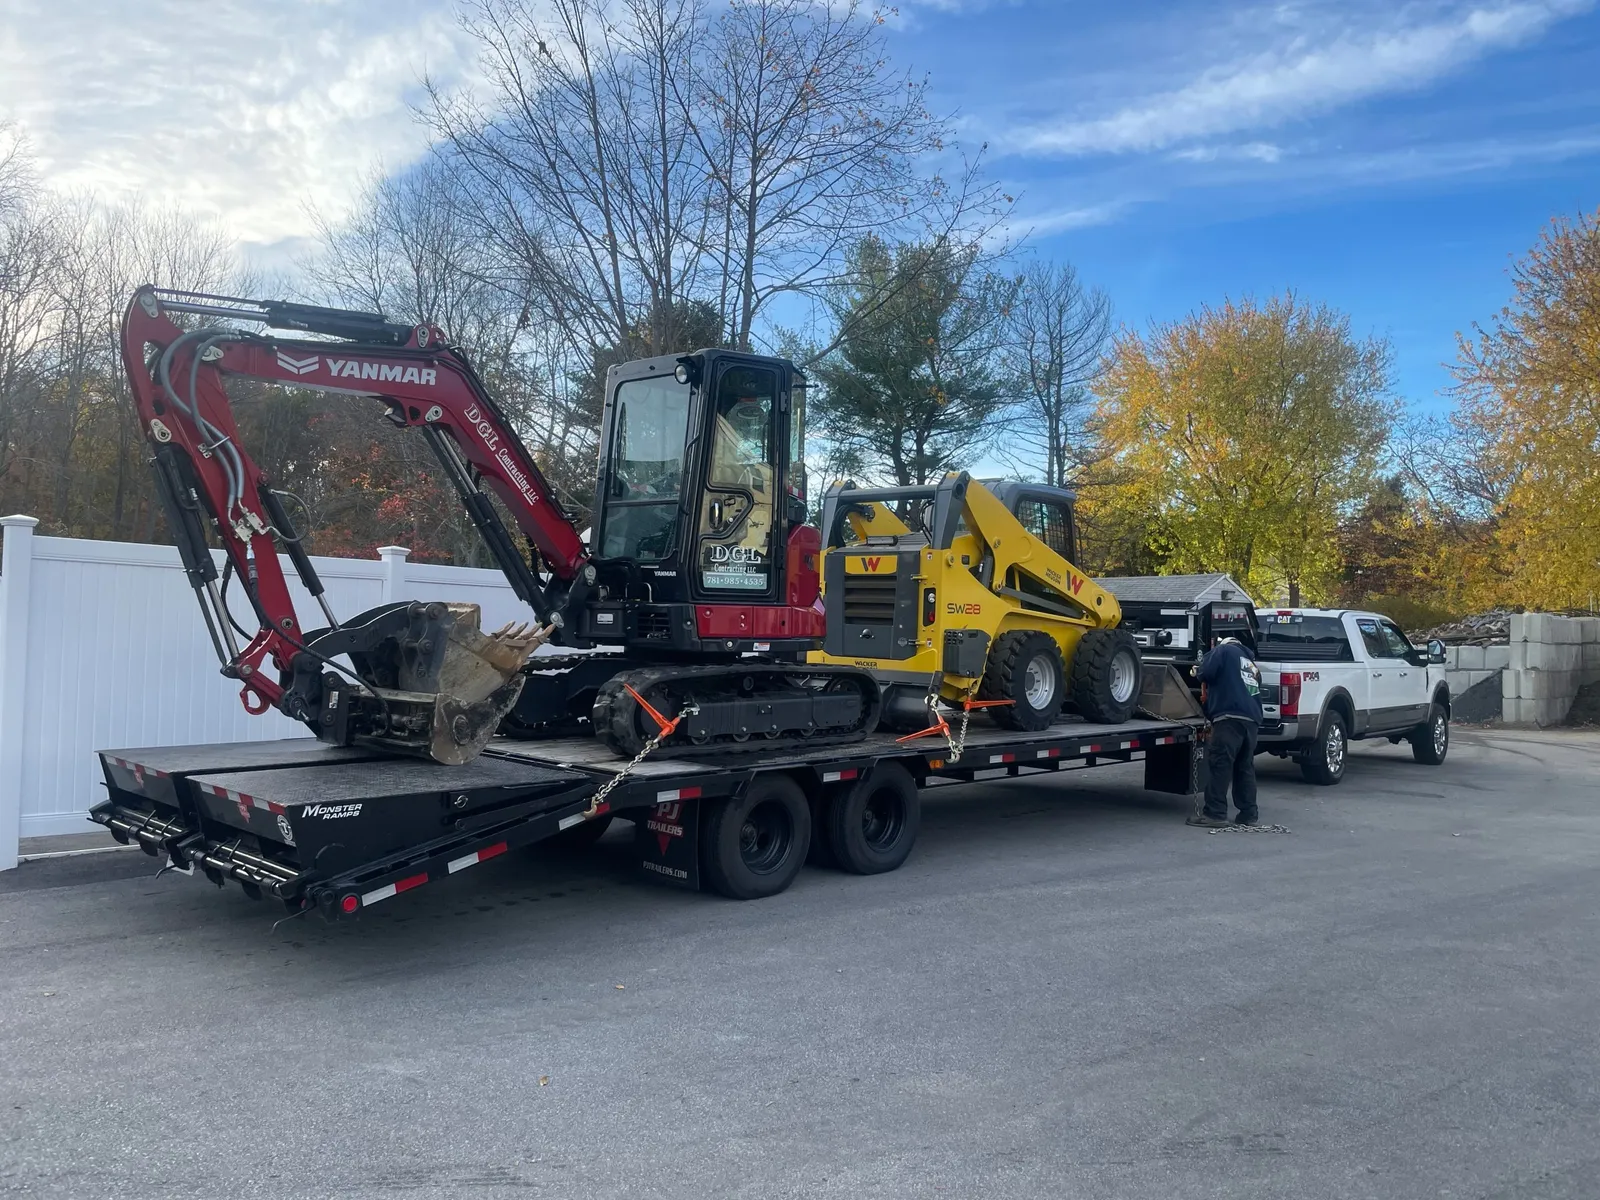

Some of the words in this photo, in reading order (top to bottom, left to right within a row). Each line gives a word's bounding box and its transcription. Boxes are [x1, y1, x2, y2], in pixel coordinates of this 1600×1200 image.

[326, 358, 437, 386] YANMAR
[464, 403, 499, 452] DGL
[498, 448, 530, 493] Contracting
[527, 489, 539, 503] LLC
[710, 544, 761, 564] DGL
[714, 563, 747, 576] Contracting
[747, 566, 757, 574] LLC
[947, 603, 981, 615] SW28
[1277, 615, 1292, 624] CAT
[1303, 672, 1320, 681] FX4
[302, 804, 363, 818] MONSTER
[322, 811, 360, 820] RAMPS
[656, 801, 680, 820] PJ
[647, 820, 683, 836] TRAILERS
[642, 860, 688, 879] PJTRAILERS.COM
